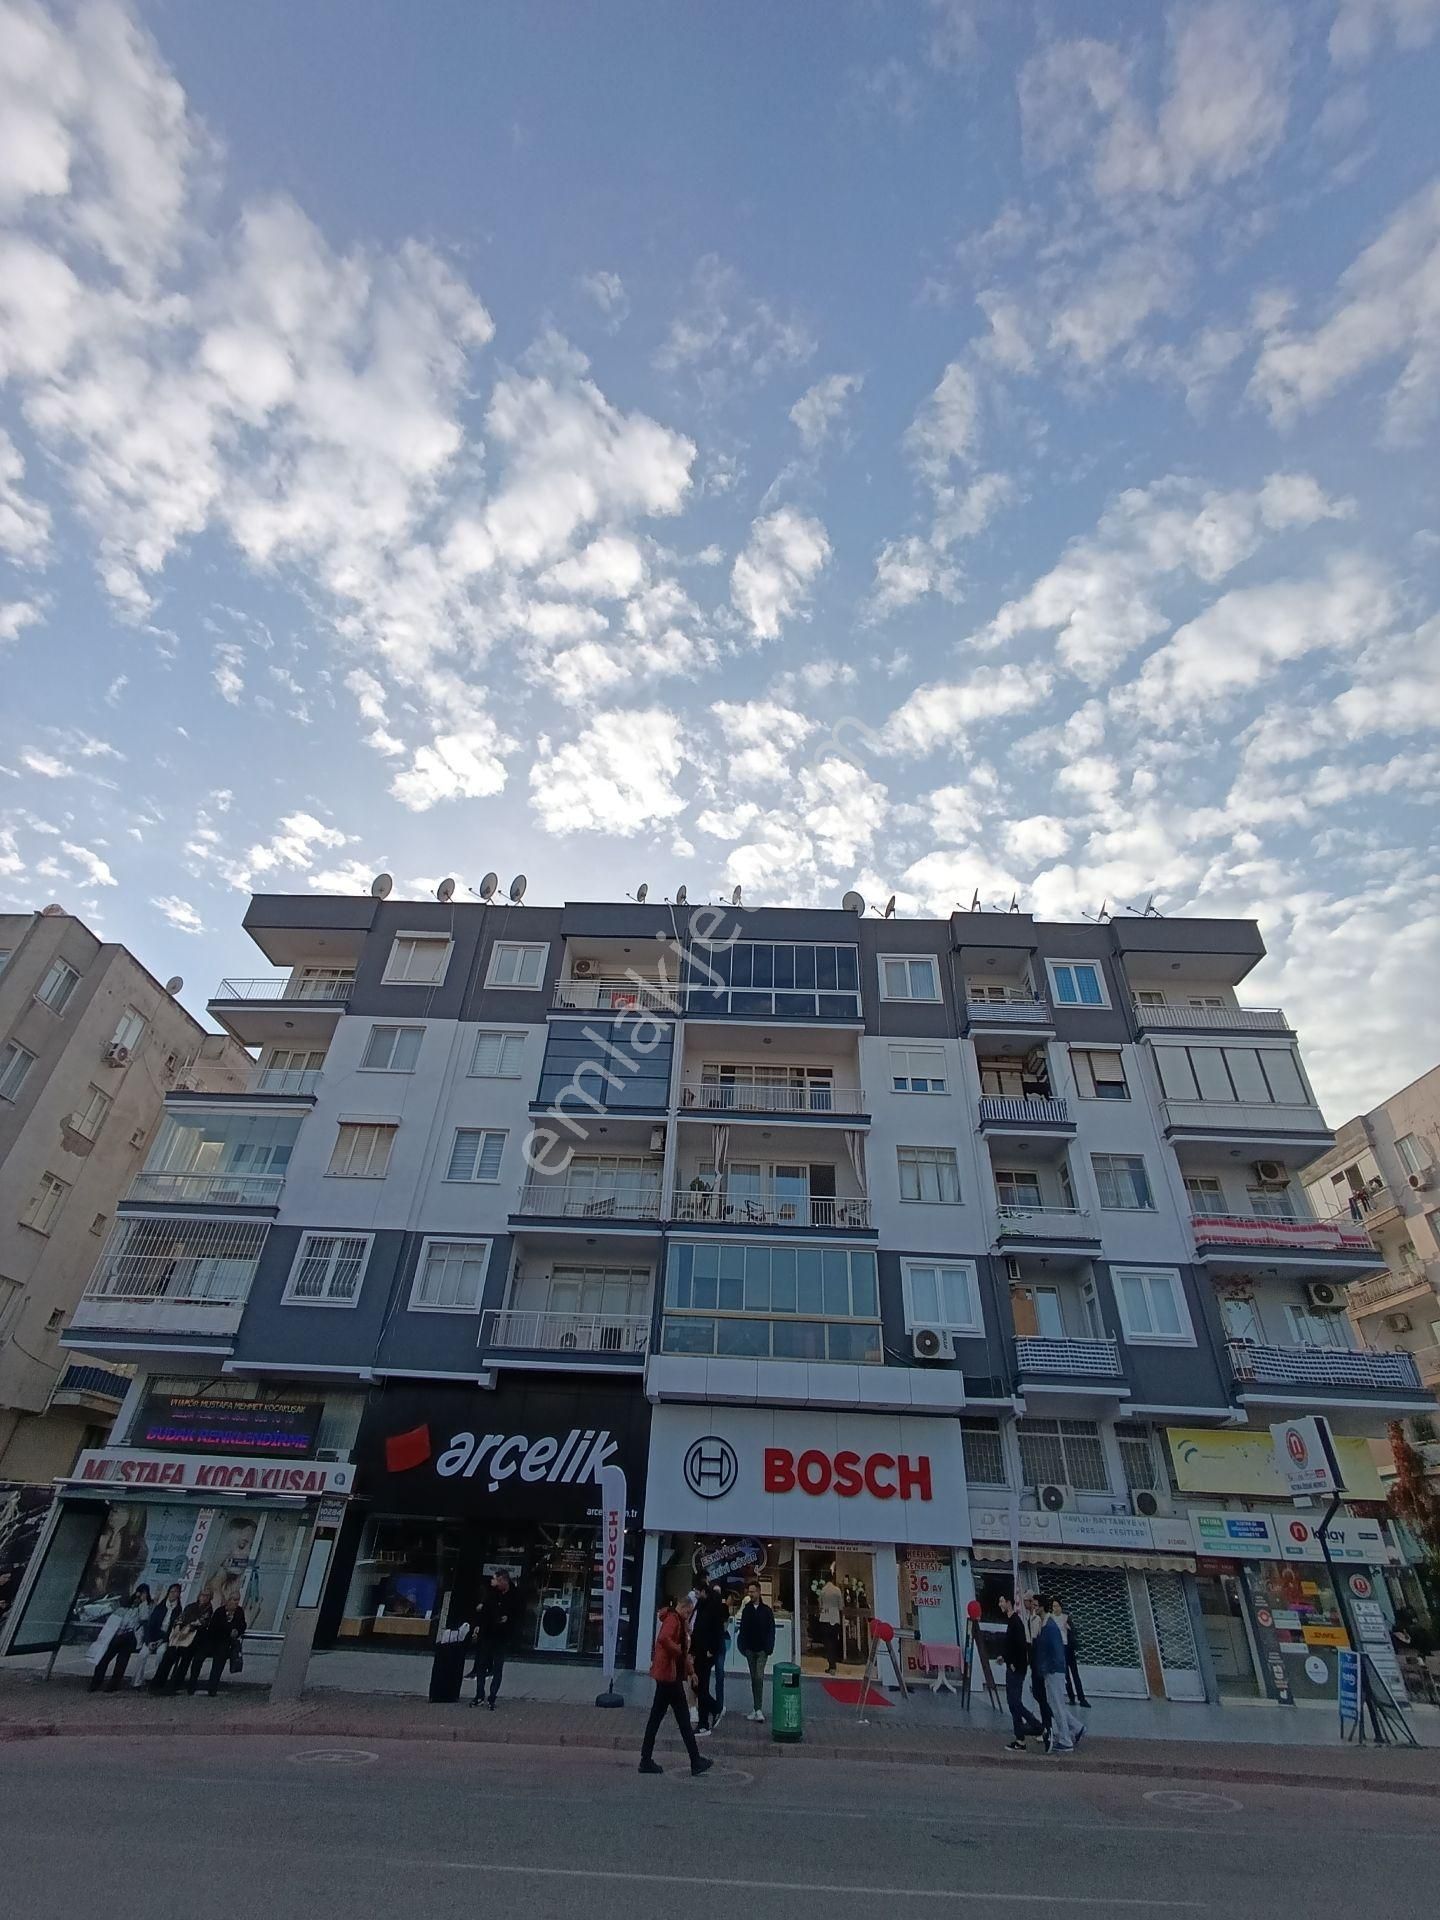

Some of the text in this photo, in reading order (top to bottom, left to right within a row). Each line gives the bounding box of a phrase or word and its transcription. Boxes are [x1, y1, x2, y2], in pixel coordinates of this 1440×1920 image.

[436, 1429, 619, 1492] arçelik
[764, 1448, 933, 1501] BOSCH
[909, 1574, 930, 1592] 36
